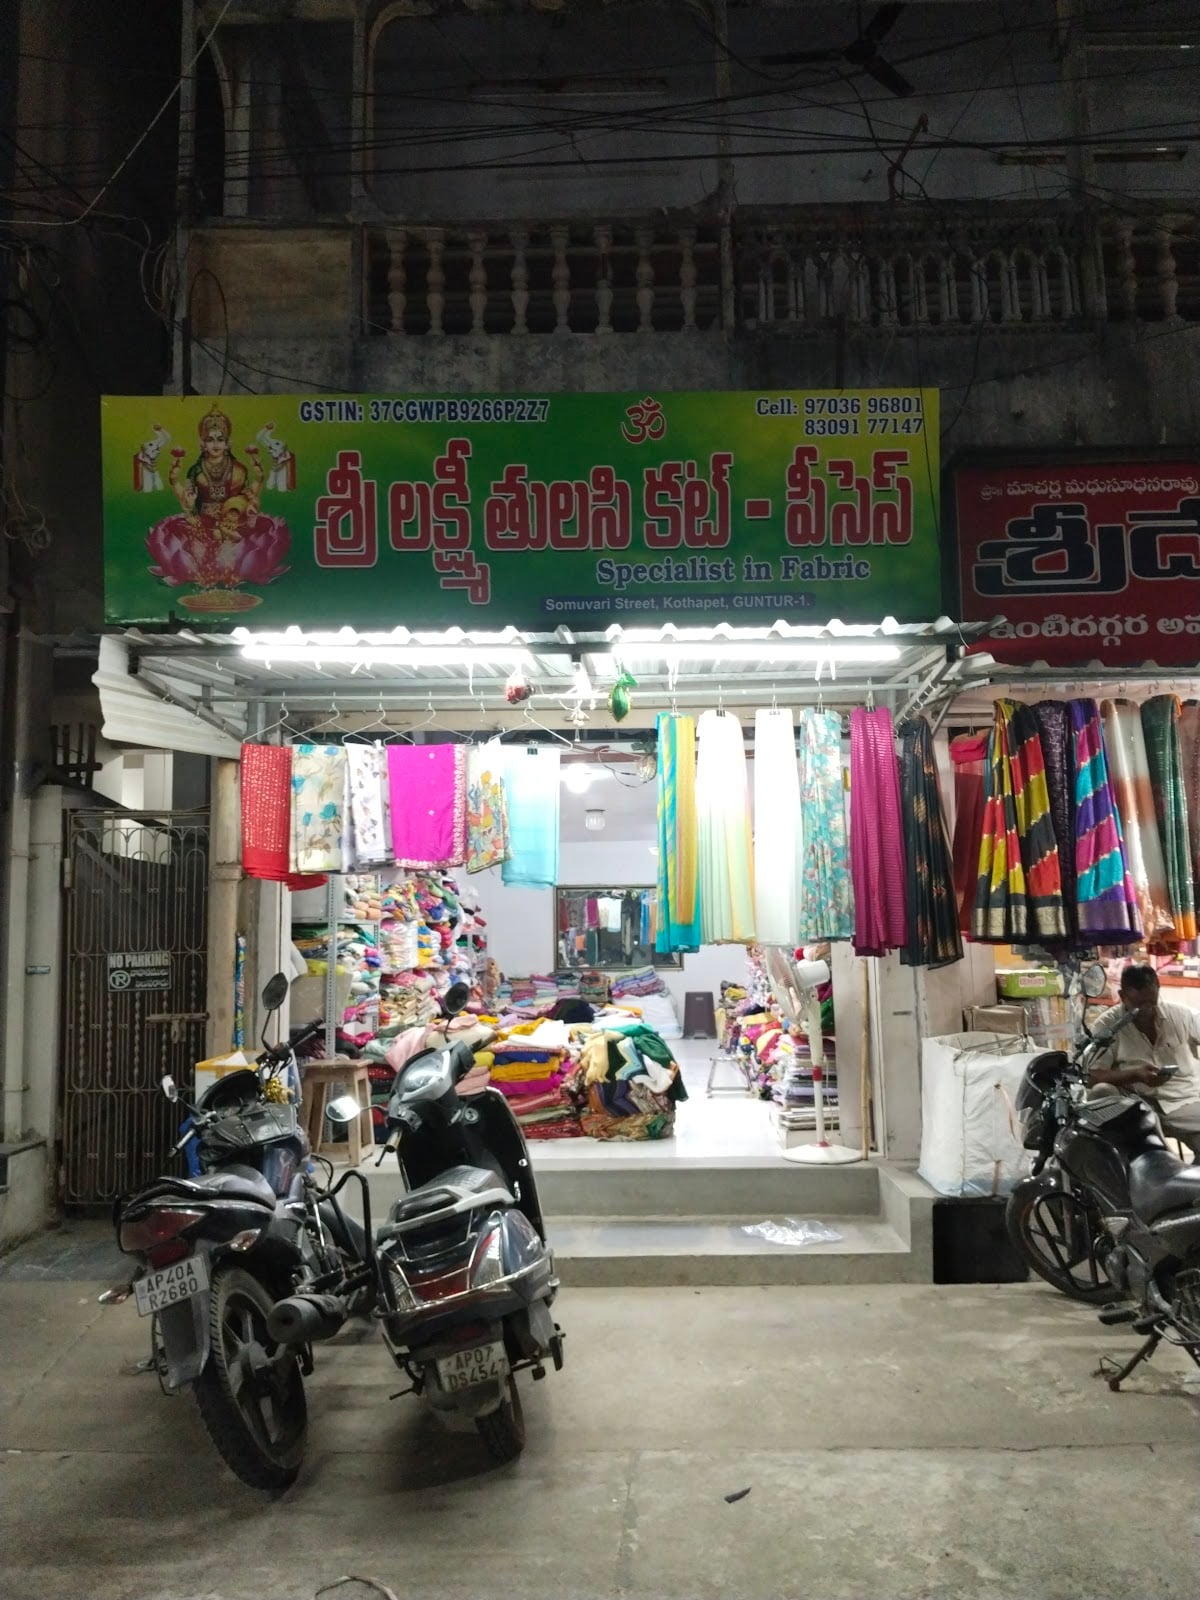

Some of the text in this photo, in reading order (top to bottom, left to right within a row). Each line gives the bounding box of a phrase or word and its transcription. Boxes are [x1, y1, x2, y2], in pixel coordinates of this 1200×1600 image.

[299, 399, 550, 423] GSTIN: 37CGWPB9266P2Z7
[756, 396, 922, 416] Cell: 97036 96801
[804, 417, 924, 436] 83091 77147
[314, 450, 378, 568] శ్రీ
[388, 438, 491, 604] లక్ష్మీ
[484, 464, 632, 551] తులసి
[643, 452, 733, 550] కట్
[785, 445, 913, 548] పీసెస్
[596, 554, 872, 590] Specialist in Fabric
[545, 597, 611, 612] Somuvari
[615, 597, 660, 611] Street,
[663, 596, 729, 611] Kothapet,
[110, 952, 169, 968] NO PARKING
[147, 1262, 194, 1293] AP40A
[149, 1278, 198, 1310] R2680
[455, 1346, 494, 1370] AP07
